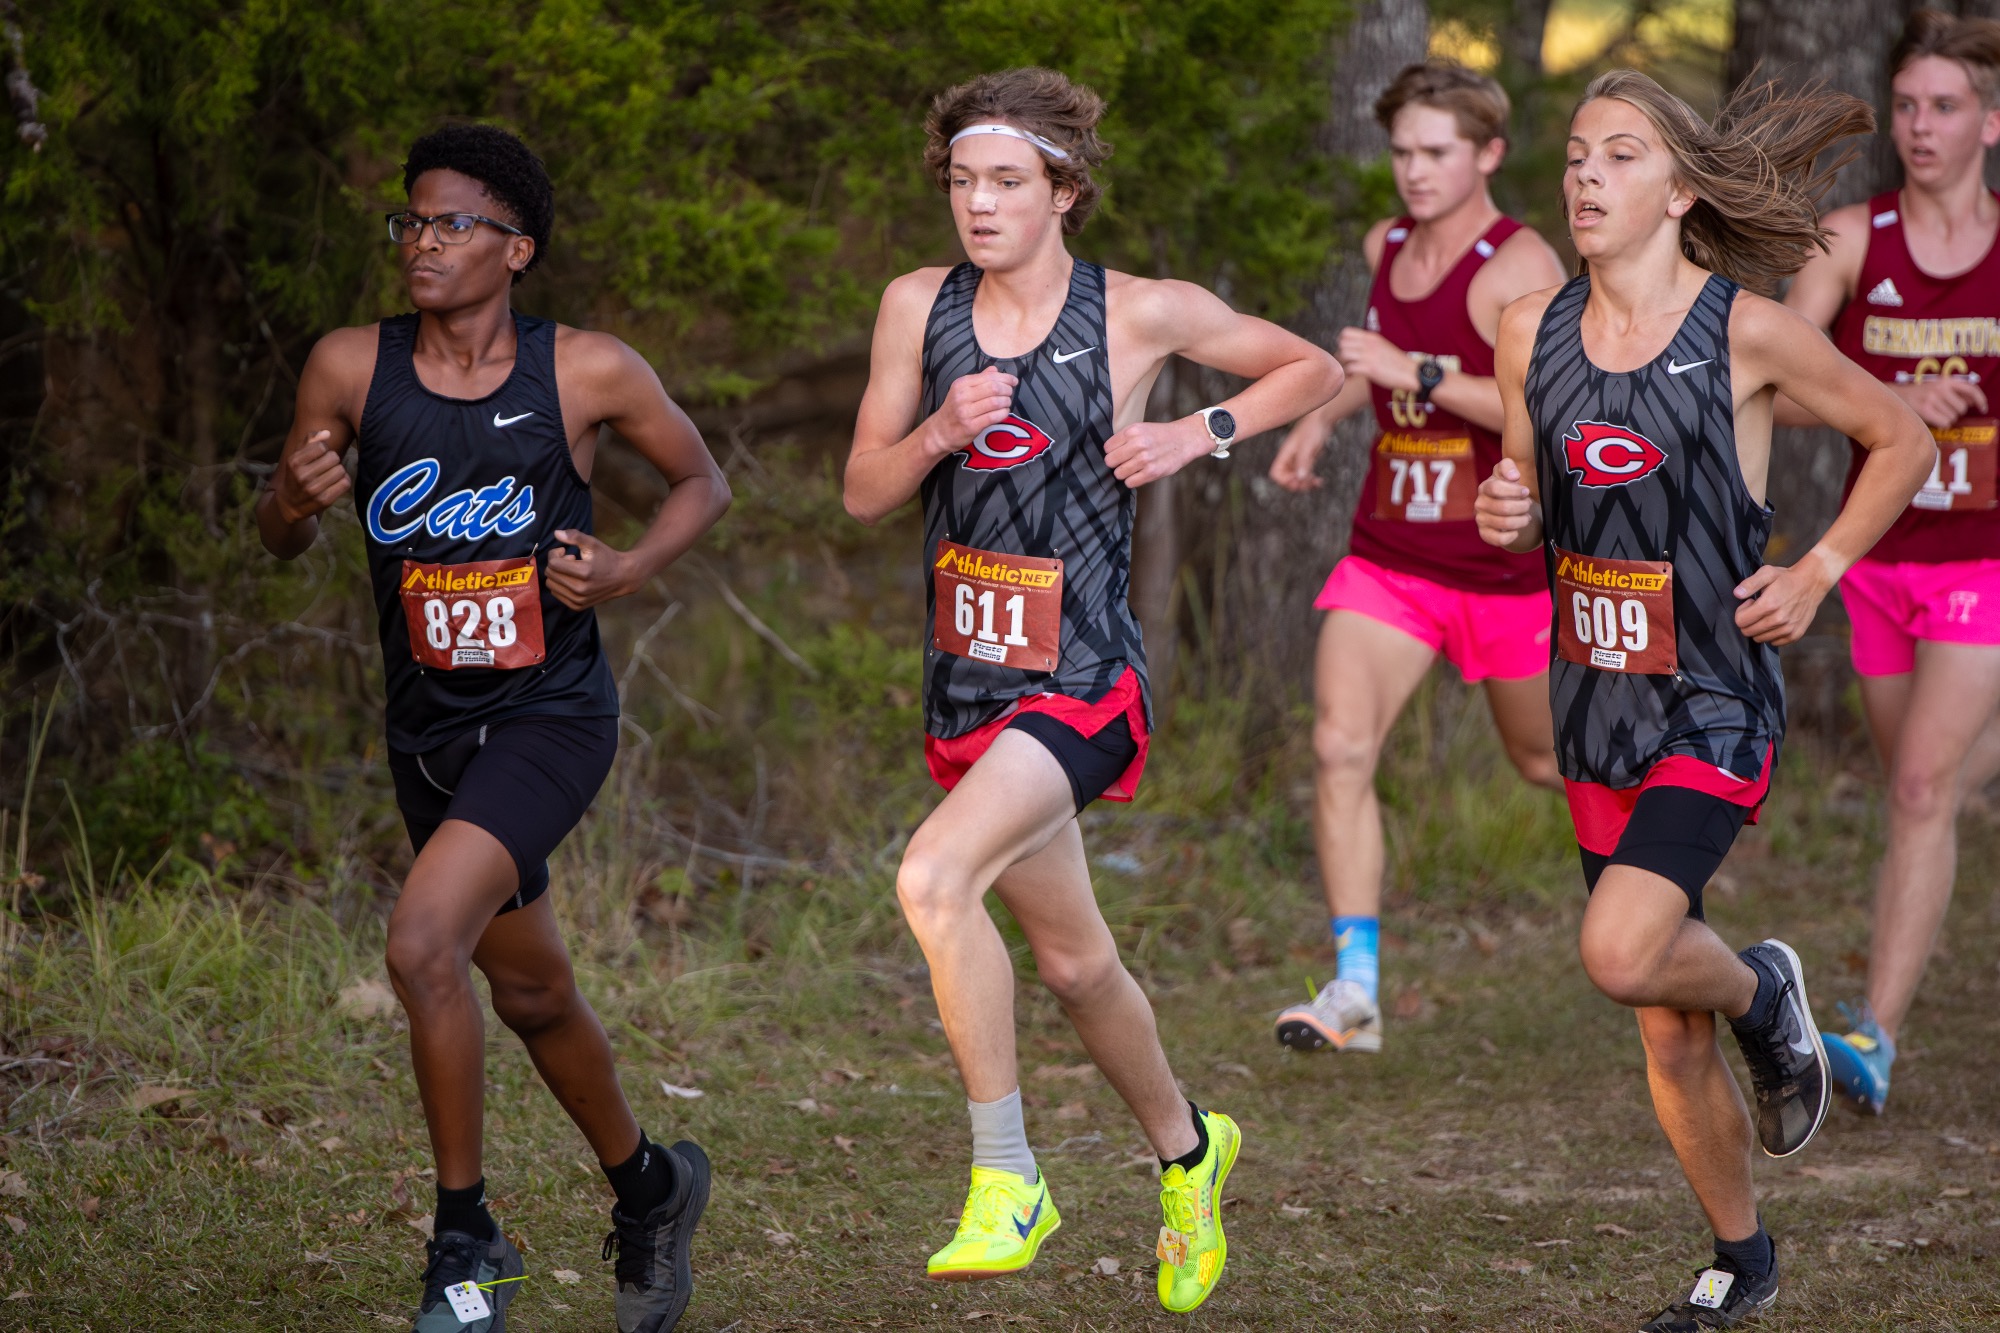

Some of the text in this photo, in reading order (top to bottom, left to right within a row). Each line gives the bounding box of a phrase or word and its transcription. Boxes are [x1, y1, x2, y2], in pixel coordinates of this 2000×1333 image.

[973, 423, 1032, 459] C
[1585, 437, 1647, 474] C
[366, 457, 536, 543] Cats
[1390, 459, 1455, 505] 717
[403, 568, 529, 591] Athletic NET
[936, 548, 1020, 583] Athletic
[1023, 572, 1053, 584] NET
[1557, 556, 1631, 588] Athletic
[1635, 577, 1661, 587] NET
[424, 596, 517, 650] 828
[955, 583, 1028, 646] 611
[1573, 591, 1648, 651] 609
